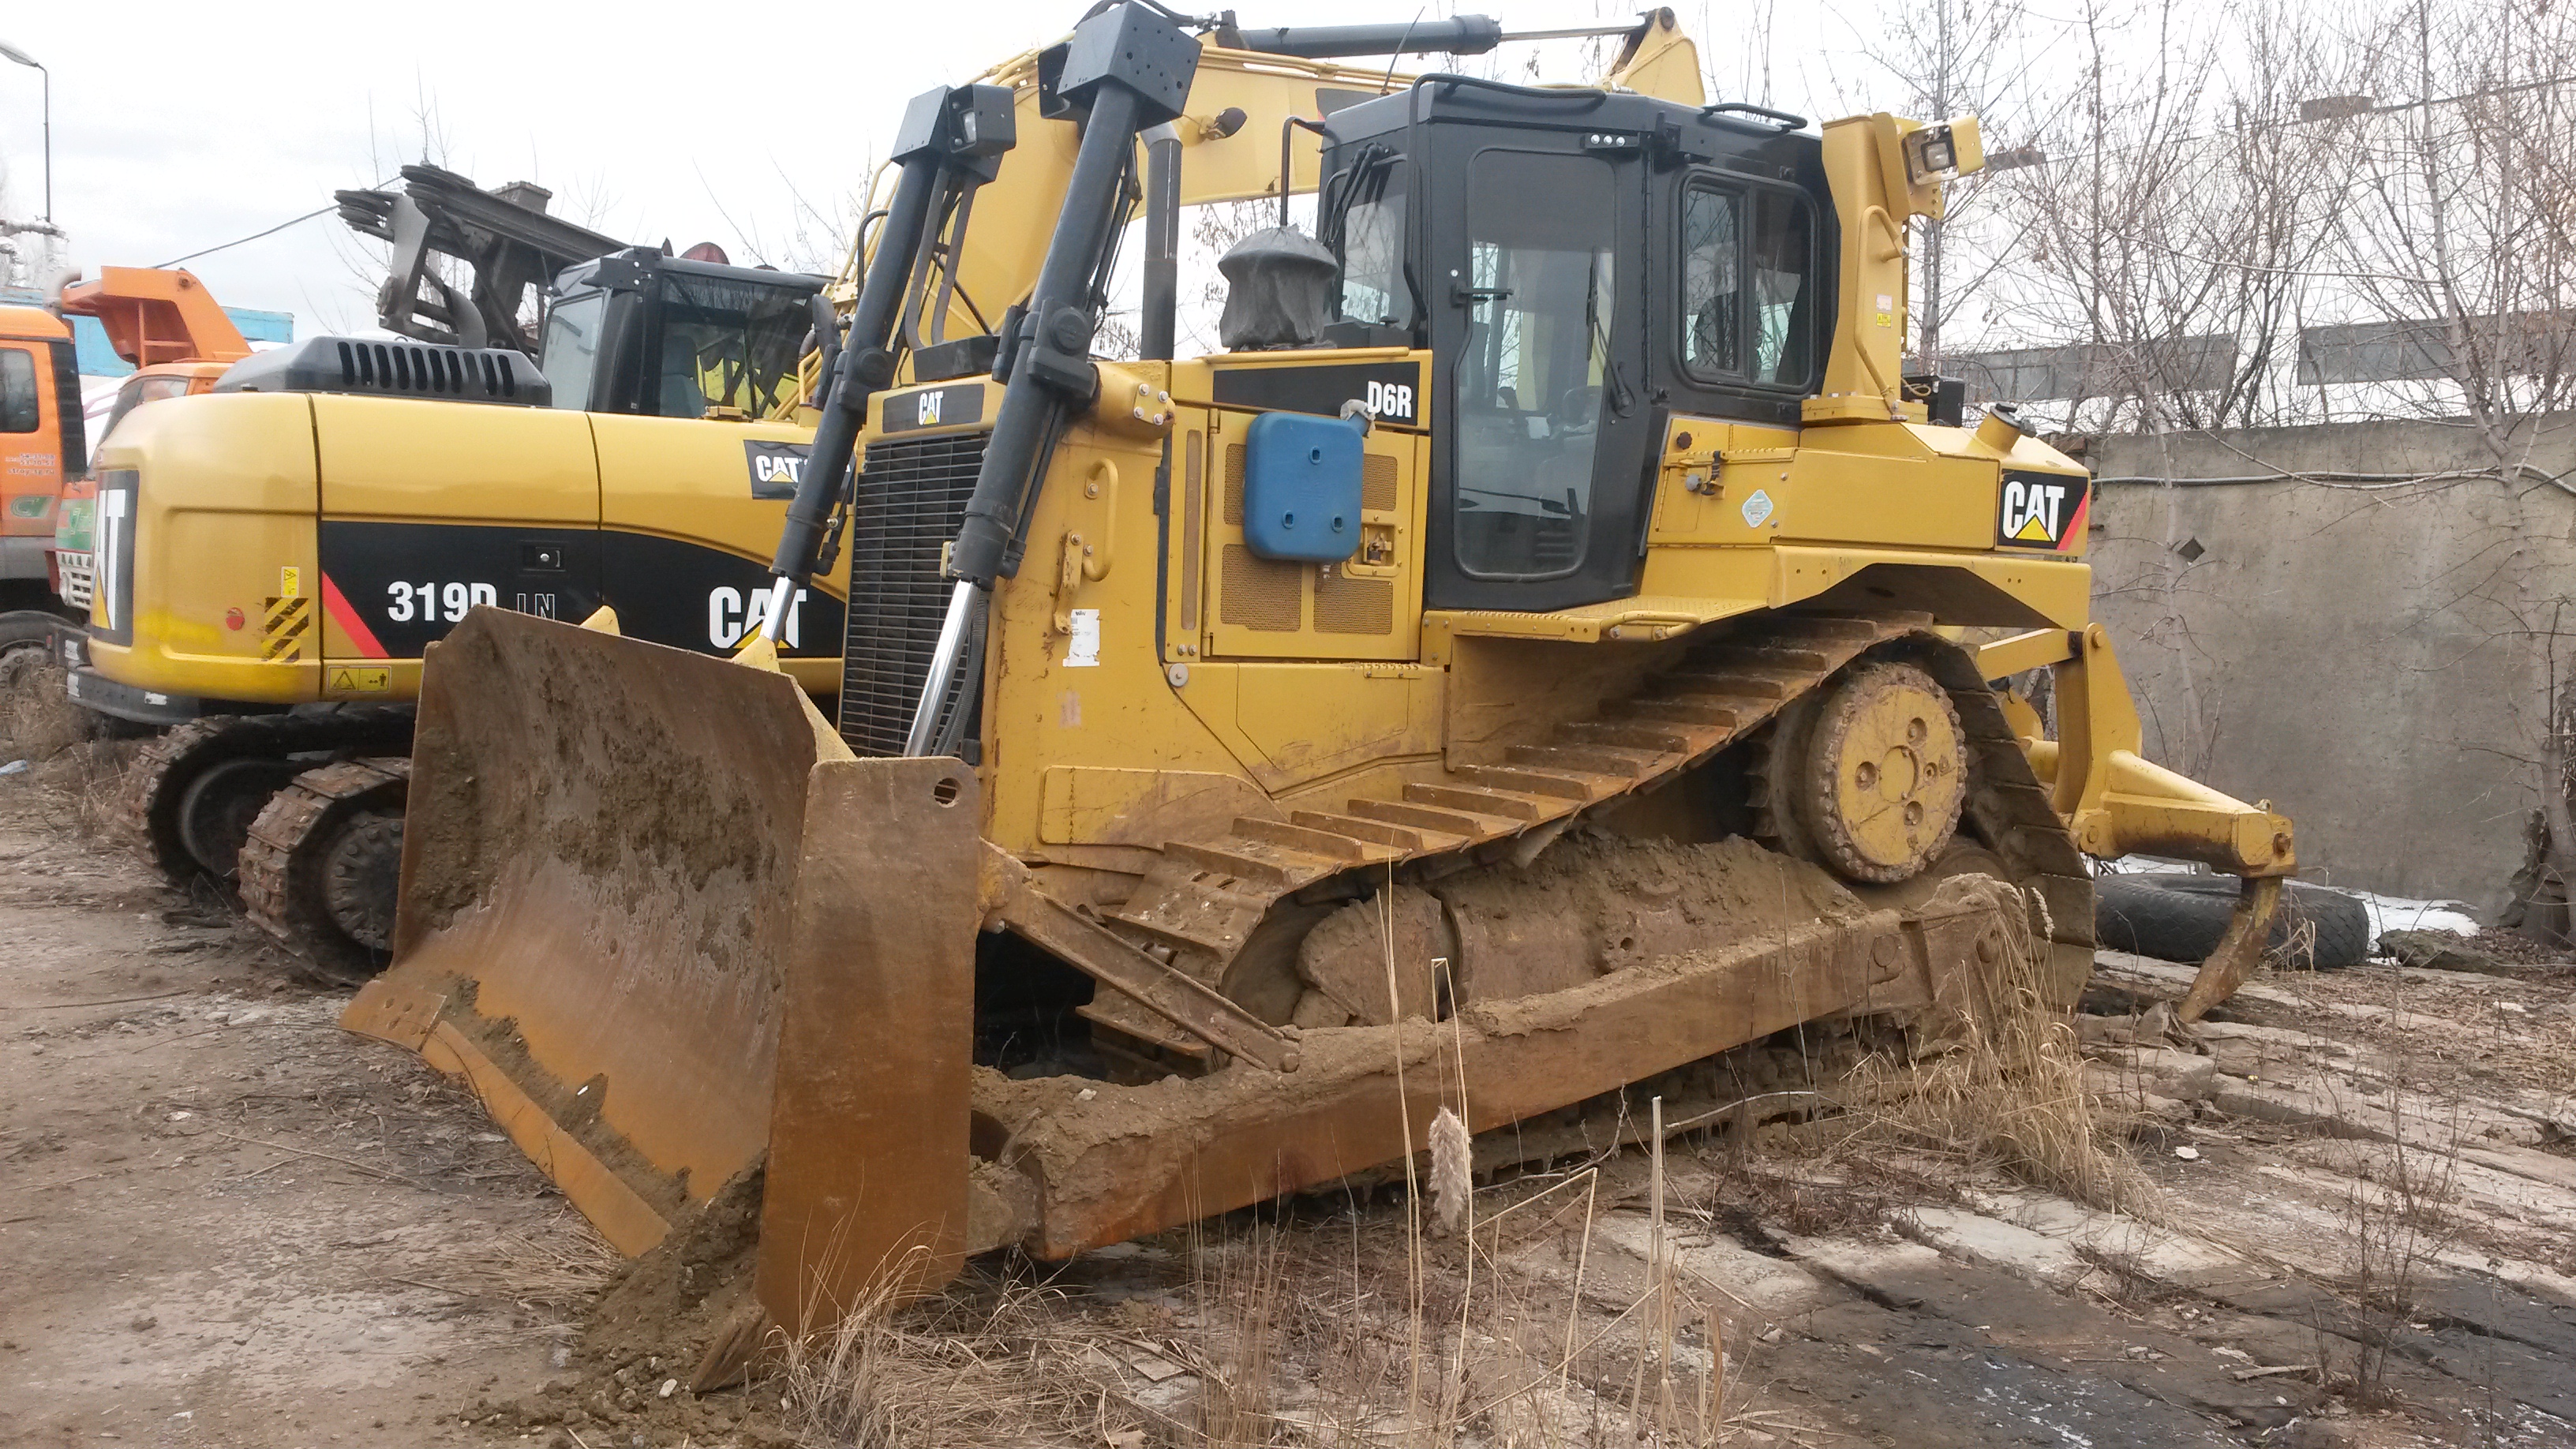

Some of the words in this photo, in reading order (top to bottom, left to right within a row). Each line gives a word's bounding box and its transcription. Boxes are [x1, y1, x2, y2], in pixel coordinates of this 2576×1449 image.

[919, 391, 943, 425] CAT
[1366, 380, 1412, 417] D6R
[755, 455, 799, 483] CAT
[2002, 481, 2065, 542] CAT
[94, 489, 126, 631] AT
[388, 581, 497, 622] 319D
[709, 586, 807, 649] CAT
